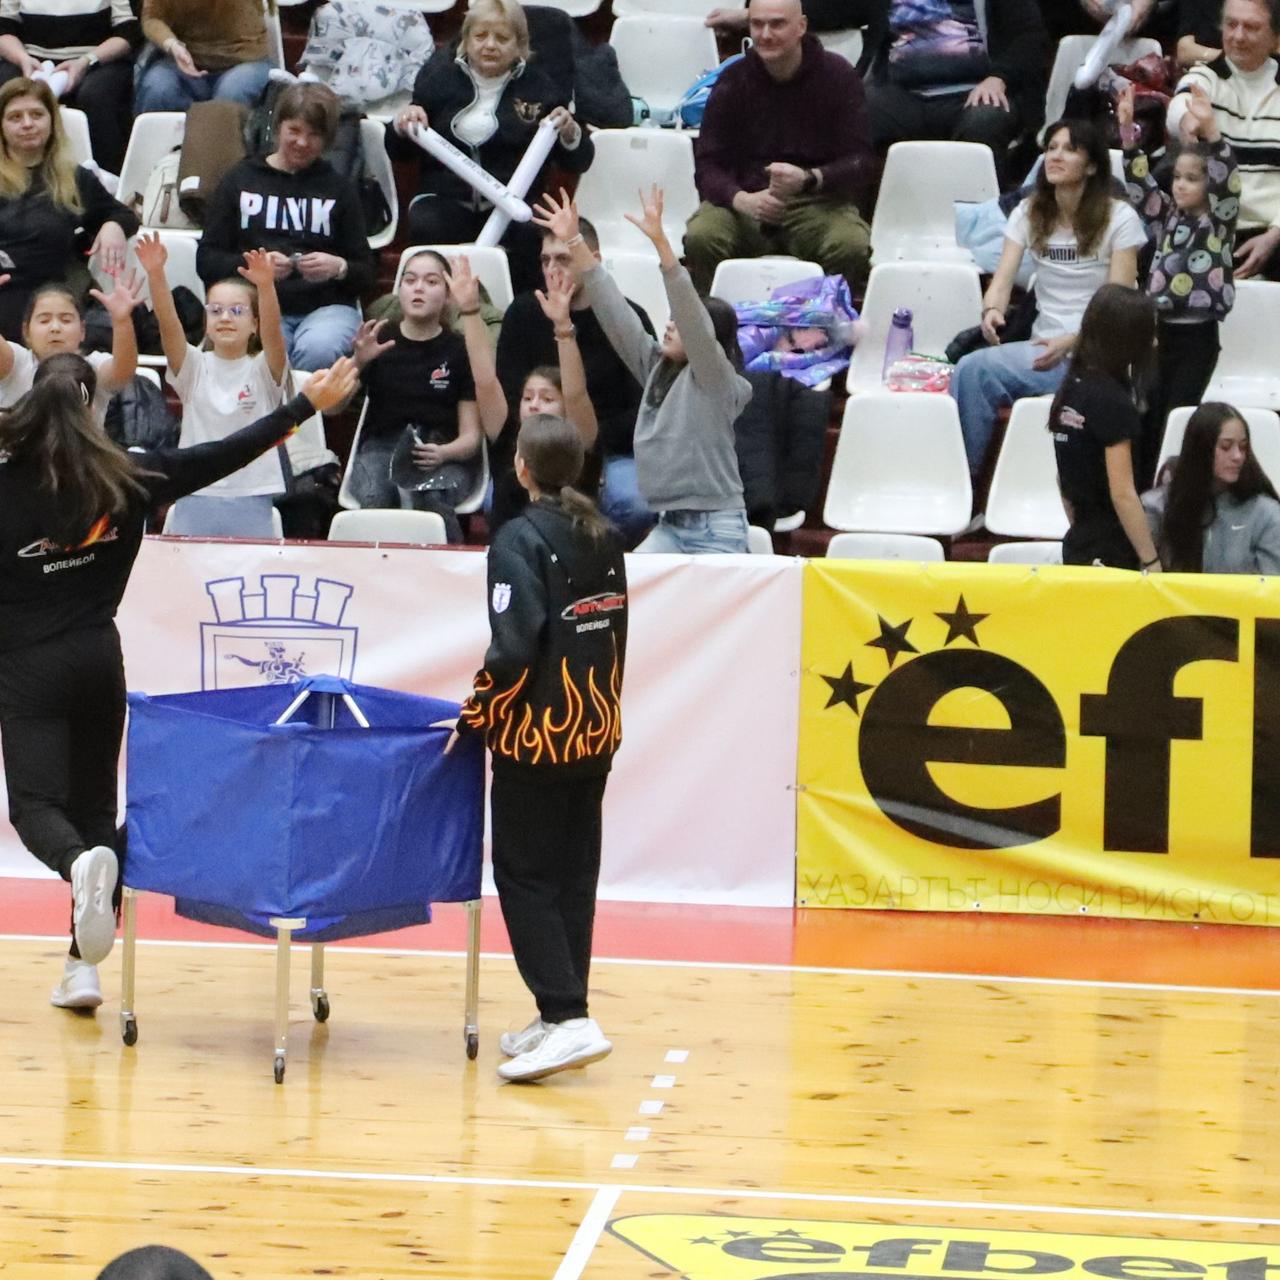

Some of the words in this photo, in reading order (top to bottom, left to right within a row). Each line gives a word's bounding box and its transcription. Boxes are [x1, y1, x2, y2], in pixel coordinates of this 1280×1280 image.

[240, 190, 336, 237] PINK
[43, 552, 95, 574] ВОЛЕЙБОЛ
[803, 872, 988, 909] ХАЗАРТЪТ
[998, 878, 1104, 913] НОСИ
[1120, 885, 1219, 922] РИСК
[1228, 890, 1277, 922] ОТ
